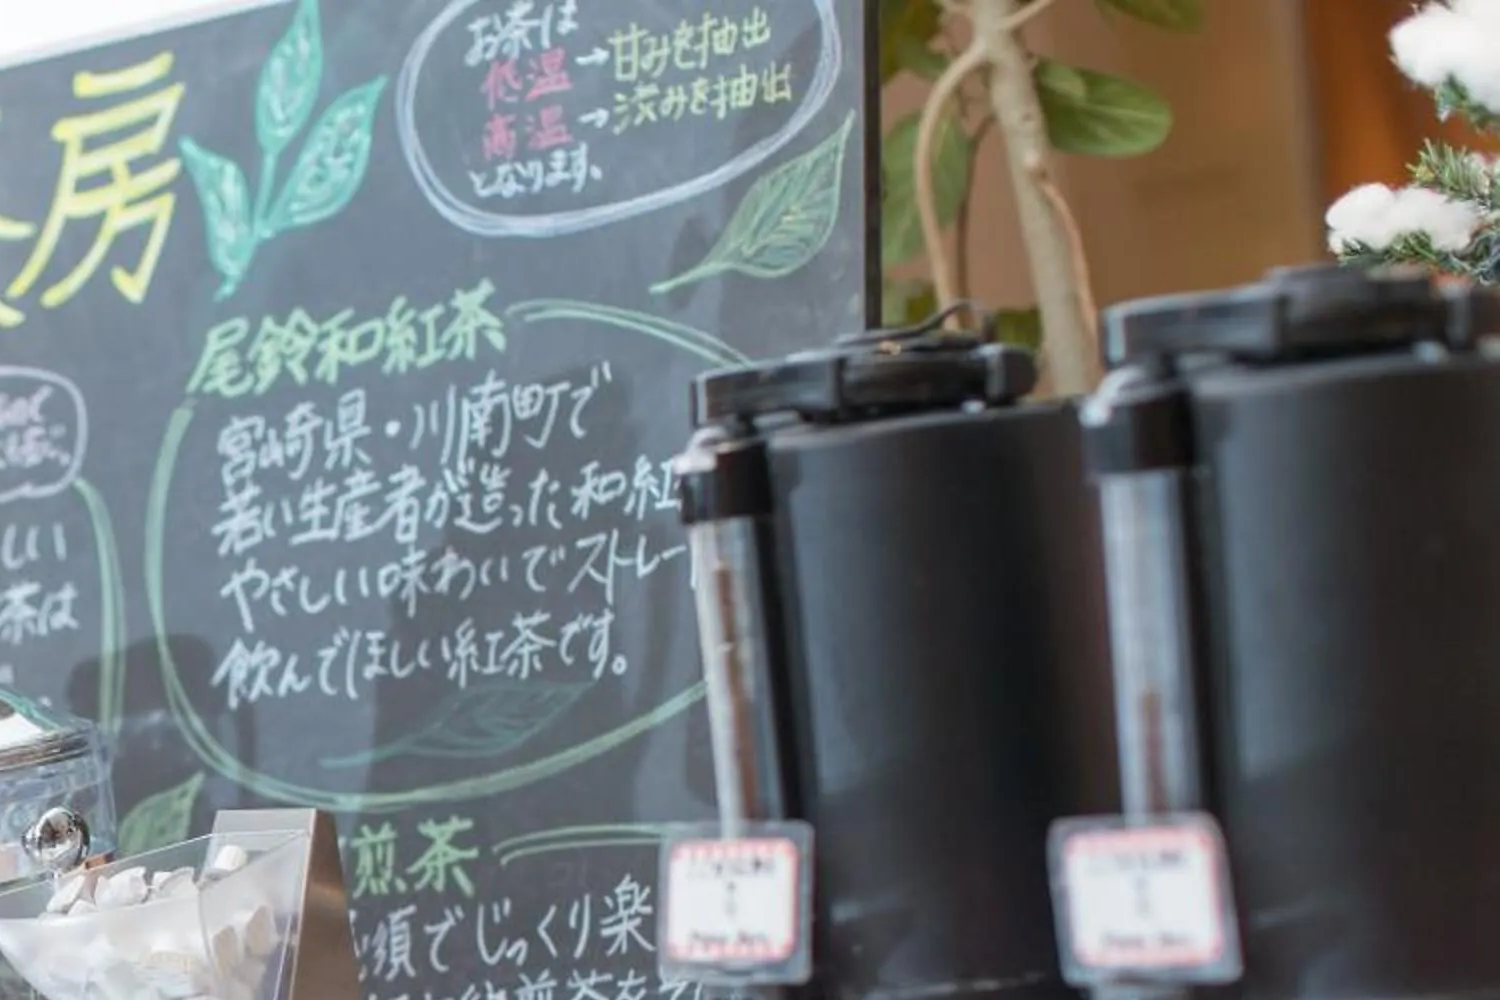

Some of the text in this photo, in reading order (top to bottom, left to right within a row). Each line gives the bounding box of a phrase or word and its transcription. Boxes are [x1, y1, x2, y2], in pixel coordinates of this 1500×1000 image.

[480, 5, 771, 111] 低温 甘みを抽出
[187, 277, 507, 399] 尾鈴和紅茶
[211, 453, 684, 559] 若い生産者が造った和紅
[338, 814, 479, 899] 煎茶
[348, 872, 657, 982] 須でじっくり楽
